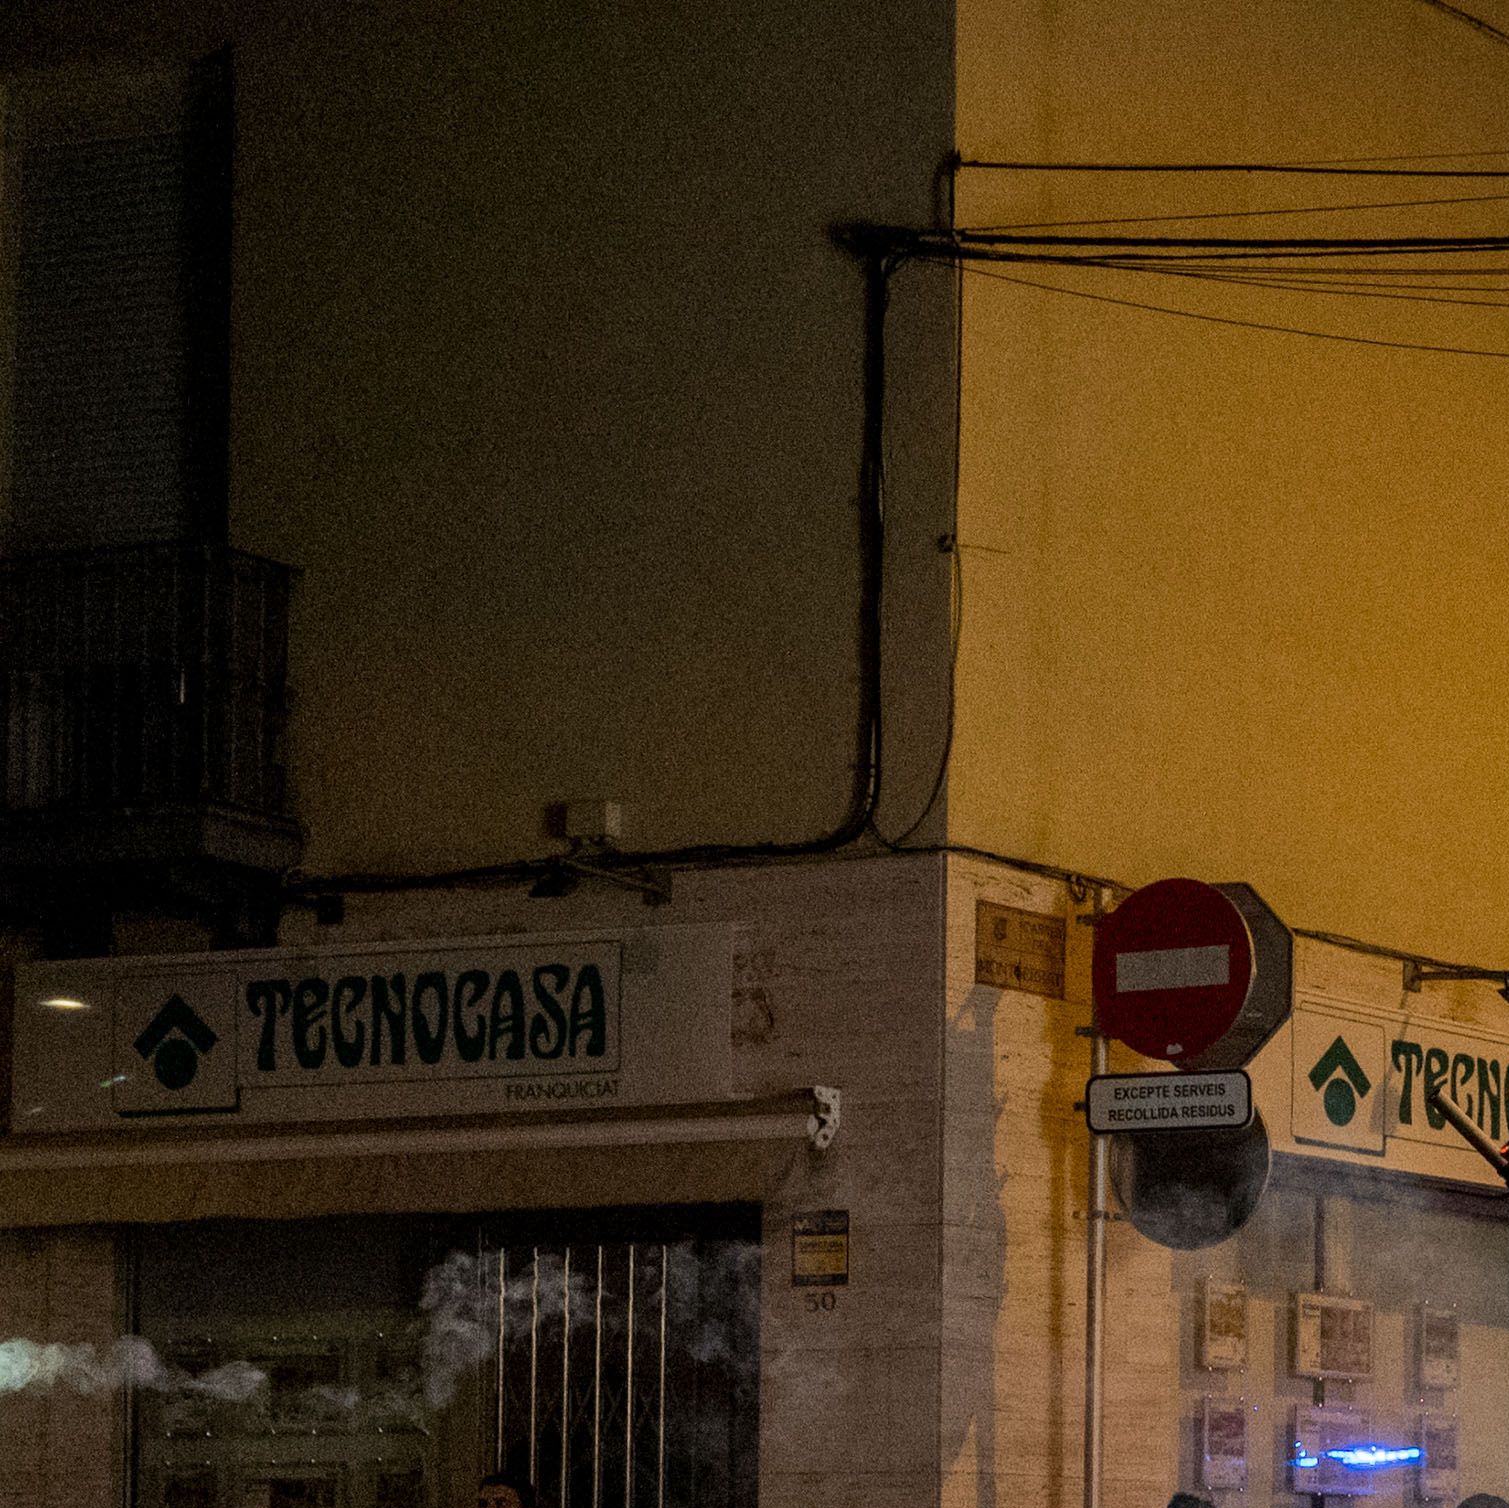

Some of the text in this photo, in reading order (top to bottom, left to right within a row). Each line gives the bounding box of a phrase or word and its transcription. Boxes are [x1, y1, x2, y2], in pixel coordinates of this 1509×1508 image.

[246, 962, 606, 1072] TECNOCASA
[505, 1079, 622, 1100] FRANQUICIAT
[1114, 1083, 1226, 1100] EXCEPTE SERVEIS
[1108, 1104, 1235, 1121] RECOLLIDA RESIDUS
[805, 1292, 836, 1312] 50
